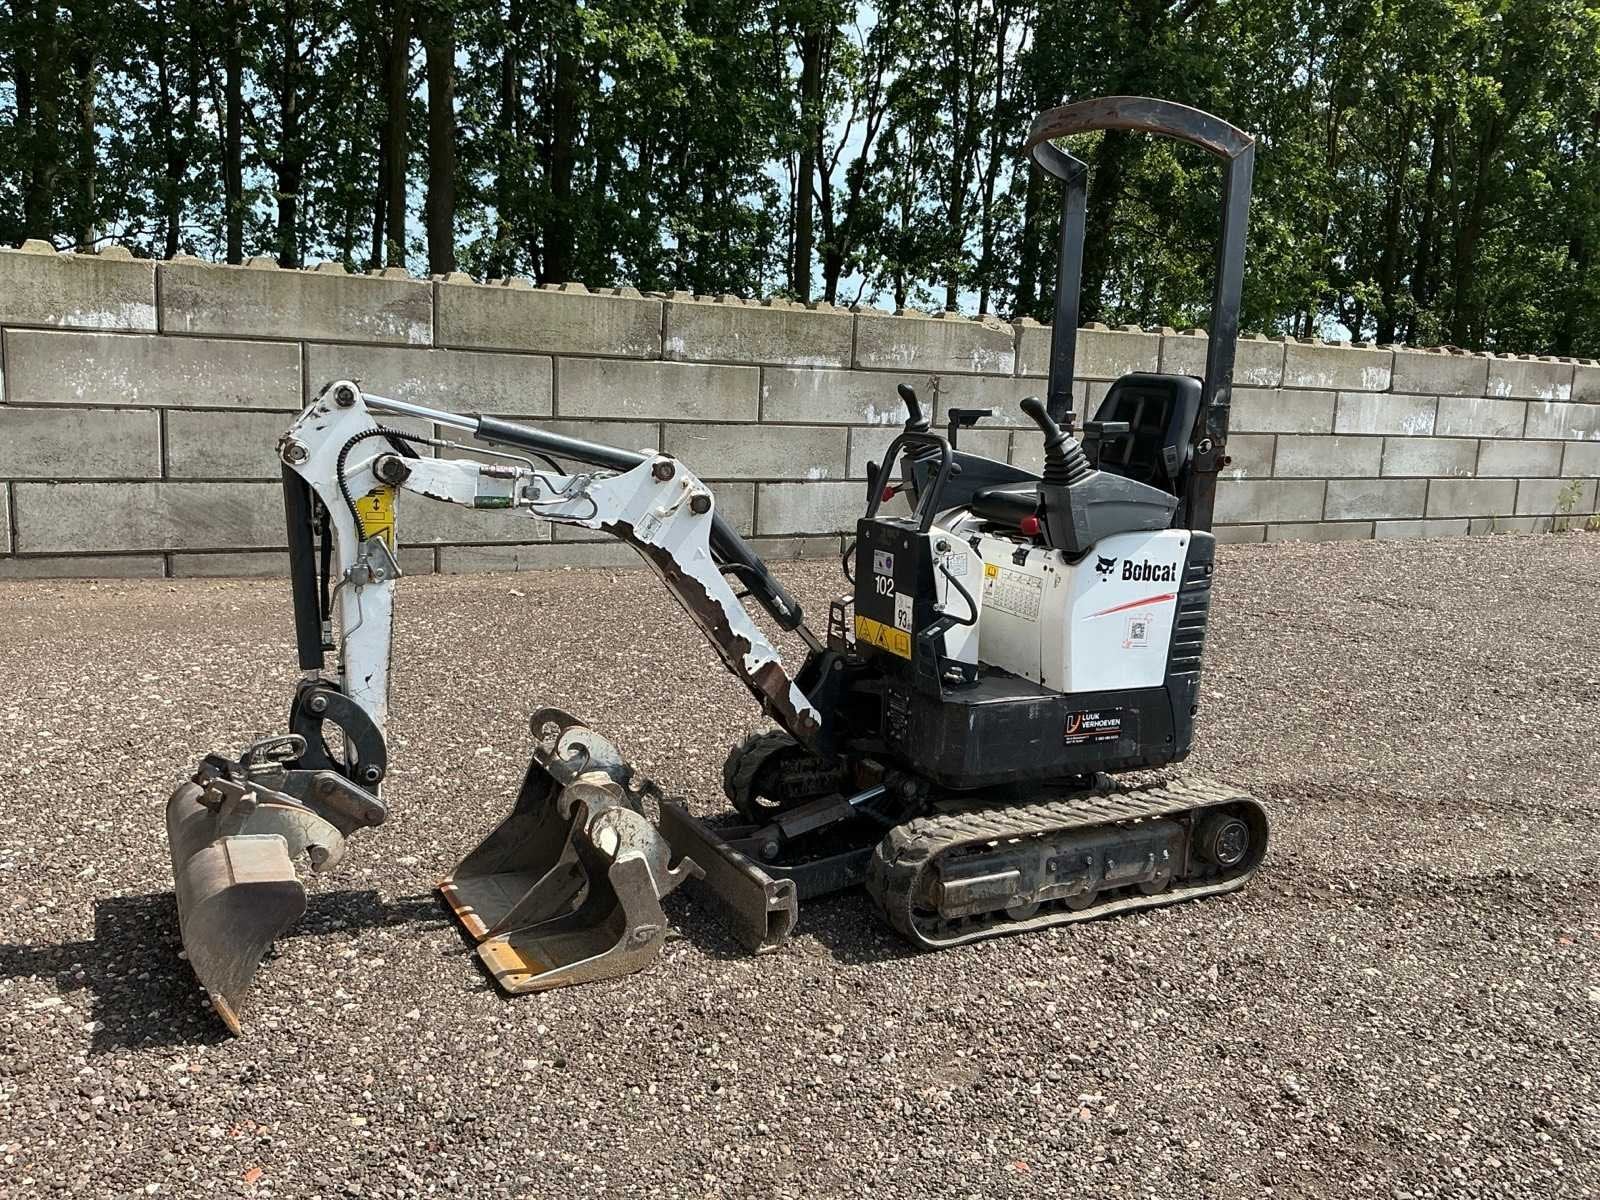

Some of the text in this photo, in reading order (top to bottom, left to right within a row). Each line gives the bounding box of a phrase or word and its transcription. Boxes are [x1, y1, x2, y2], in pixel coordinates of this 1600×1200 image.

[1121, 559, 1176, 582] Bobcat
[875, 575, 895, 598] 102
[898, 609, 907, 628] 93
[1082, 712, 1100, 721] LUUK
[1082, 718, 1121, 729] VERHOEVEN
